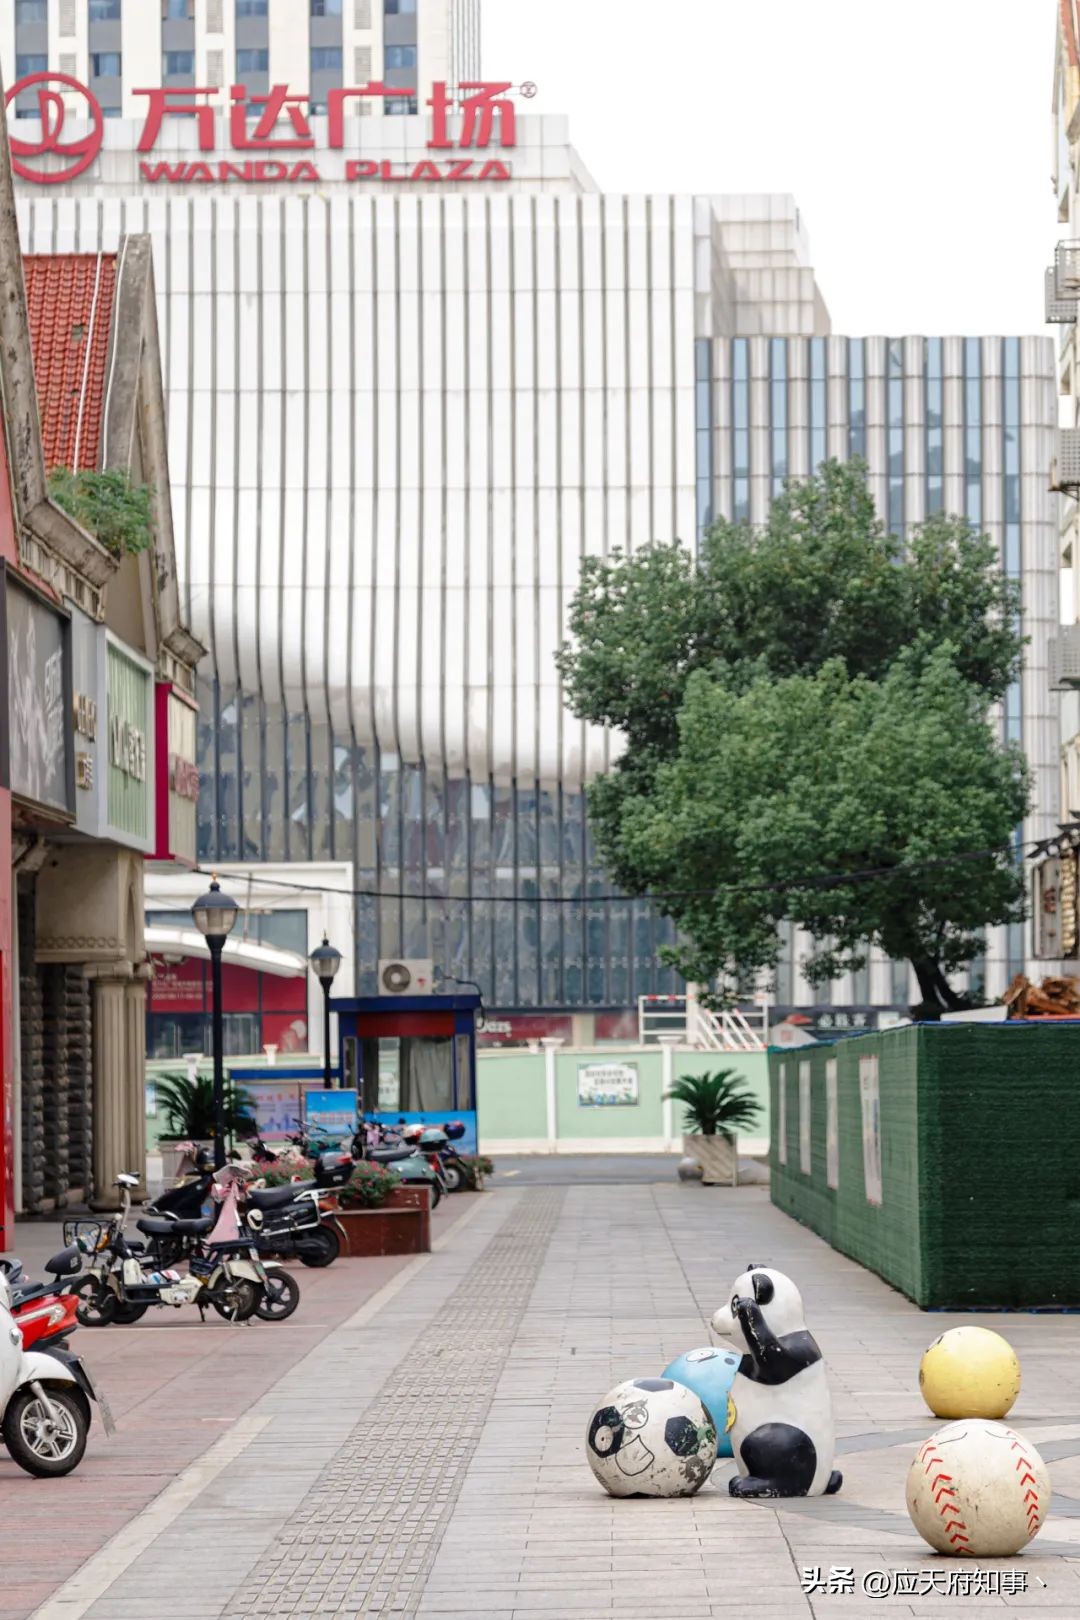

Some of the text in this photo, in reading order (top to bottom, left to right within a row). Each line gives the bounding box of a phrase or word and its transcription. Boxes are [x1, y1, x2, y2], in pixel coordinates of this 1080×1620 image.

[132, 81, 516, 152] 万达广场
[139, 160, 512, 182] WANDA PLAZA
